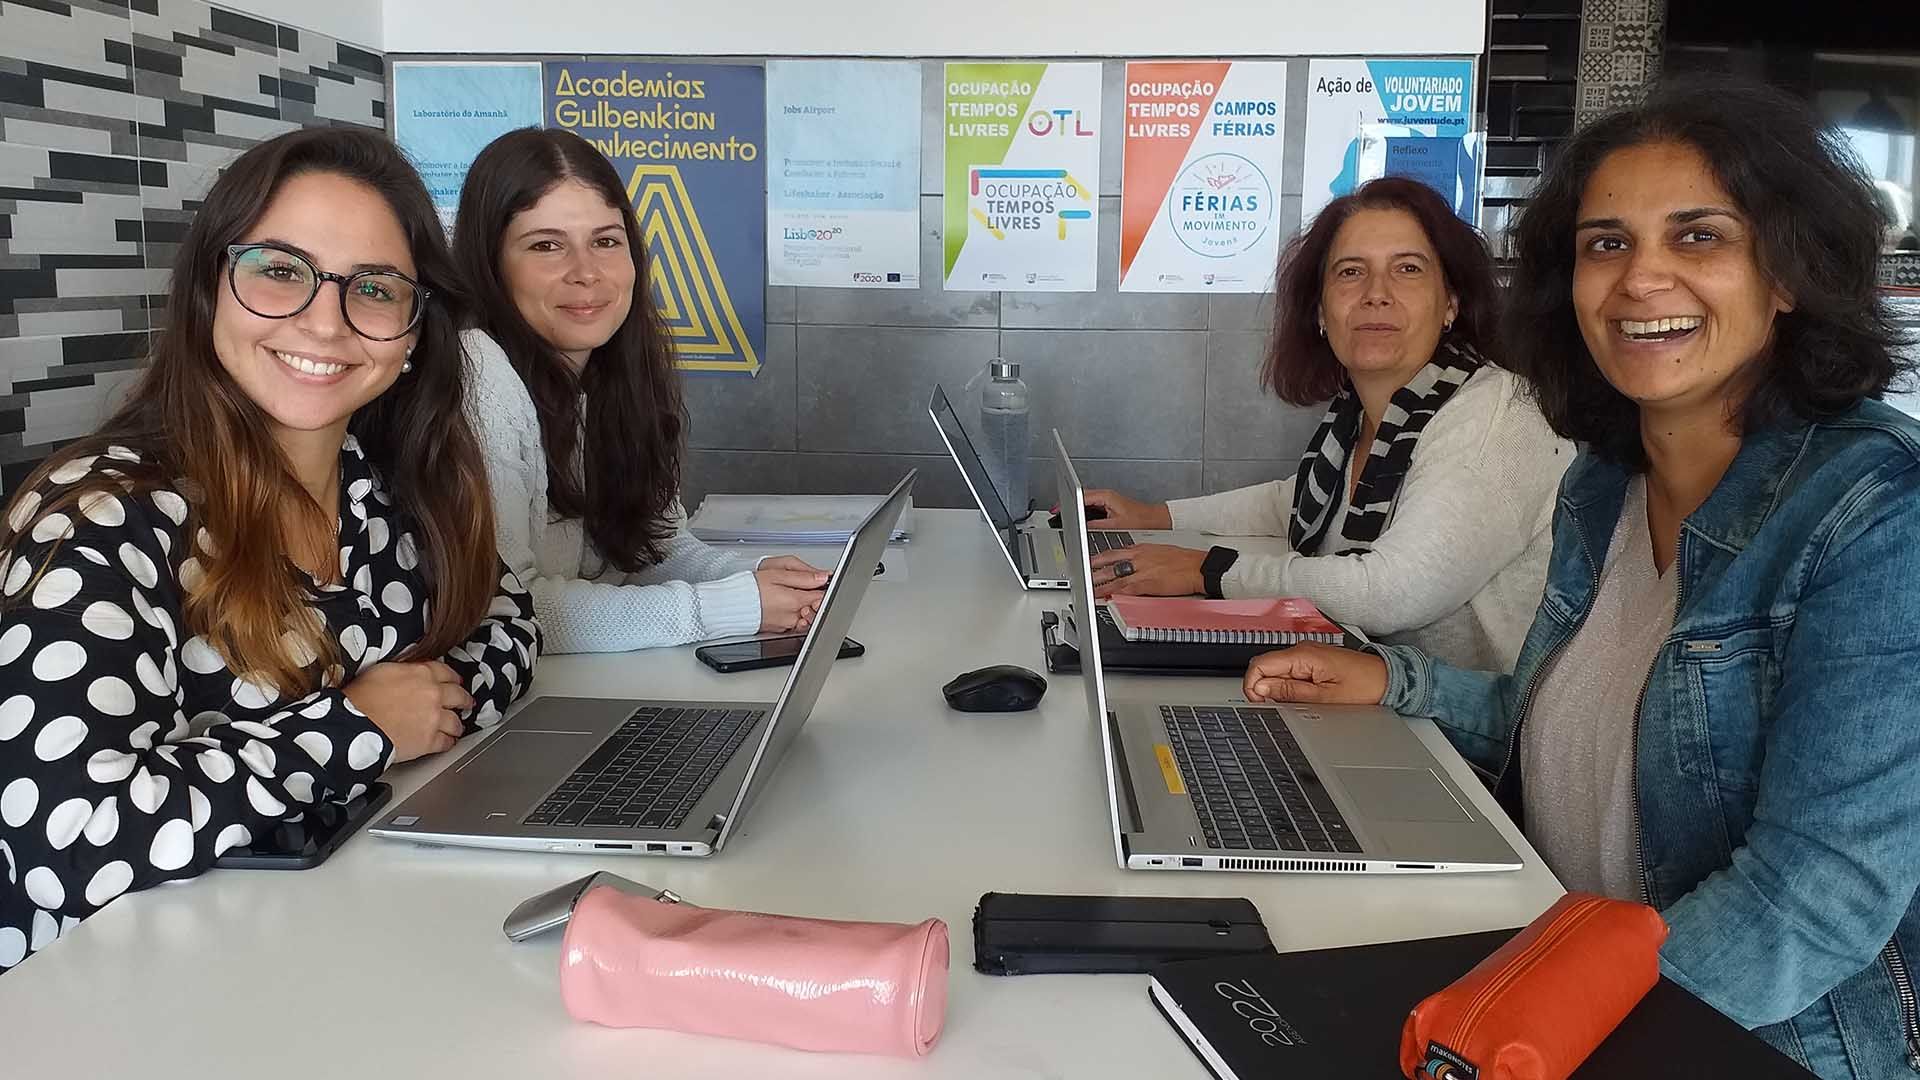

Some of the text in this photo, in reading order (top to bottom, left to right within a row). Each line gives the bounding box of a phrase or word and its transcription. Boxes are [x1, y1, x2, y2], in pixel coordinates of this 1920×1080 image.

[555, 69, 705, 98] Academias
[948, 80, 1031, 98] OCUPAÇÃO
[1128, 80, 1214, 98] OCUPAÇÃO
[1316, 77, 1373, 97] Ação de
[1384, 76, 1463, 94] VOLUNTARIADO
[783, 105, 836, 116] Jobs Airport
[948, 103, 1018, 117] TEMPOS
[1128, 102, 1200, 117] TEMPOS
[1214, 101, 1276, 116] CAMPOS
[1390, 95, 1462, 112] JOVEM
[413, 110, 509, 118] Laboratório do Amanhã
[555, 99, 716, 130] Gulbenkian
[1377, 116, 1465, 126] www.juventude.pt
[949, 123, 1009, 137] LIVRES
[1028, 109, 1094, 137] OTL
[1128, 124, 1191, 137] LIVRES
[1212, 120, 1276, 136] FÉRIAS
[566, 129, 758, 161] nhecimento
[1392, 145, 1429, 155] Reflexo
[985, 182, 1077, 200] OCUPAÇÃO
[986, 200, 1055, 214] TEMPOS
[1182, 192, 1258, 212] FÉRIAS
[987, 216, 1041, 230] LIVRES
[1183, 220, 1257, 231] MOVIMENTO
[1214, 978, 1295, 1047] 2022
